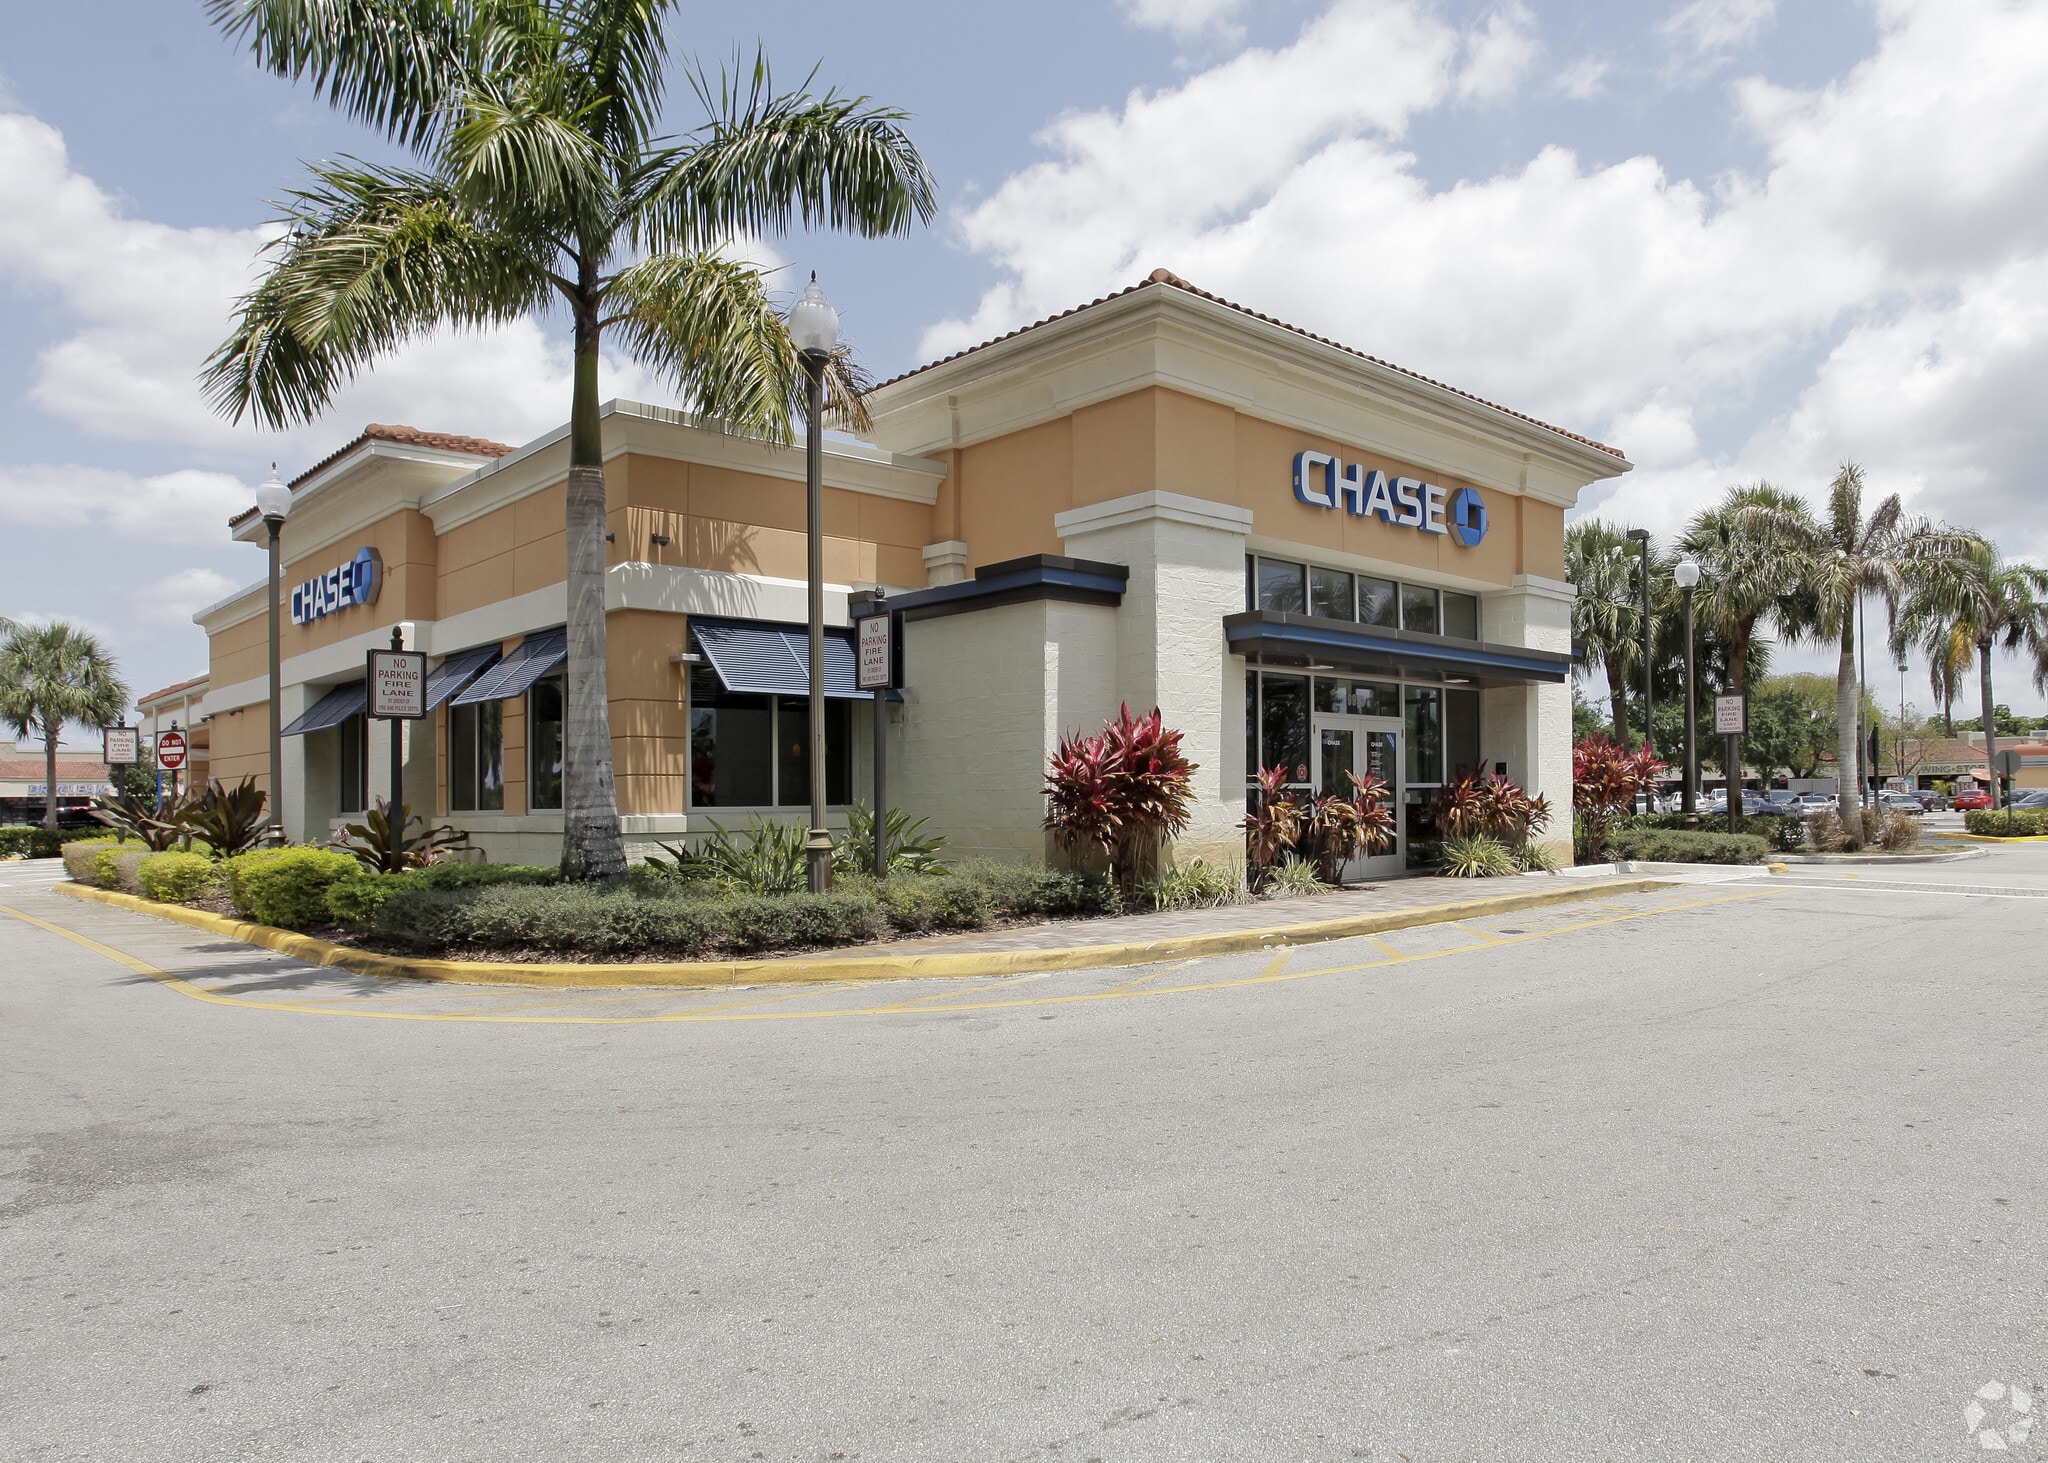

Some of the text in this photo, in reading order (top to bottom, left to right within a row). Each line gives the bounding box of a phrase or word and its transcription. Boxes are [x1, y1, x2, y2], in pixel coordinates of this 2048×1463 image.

[1295, 450, 1448, 535] CHASE
[291, 560, 353, 626] CHASE
[870, 622, 878, 633] NO
[862, 635, 886, 647] PARKING
[865, 647, 882, 655] FIRE
[394, 659, 406, 668] NO
[864, 657, 883, 665] LANE
[379, 670, 418, 680] PARKING
[27, 784, 61, 795] DR
